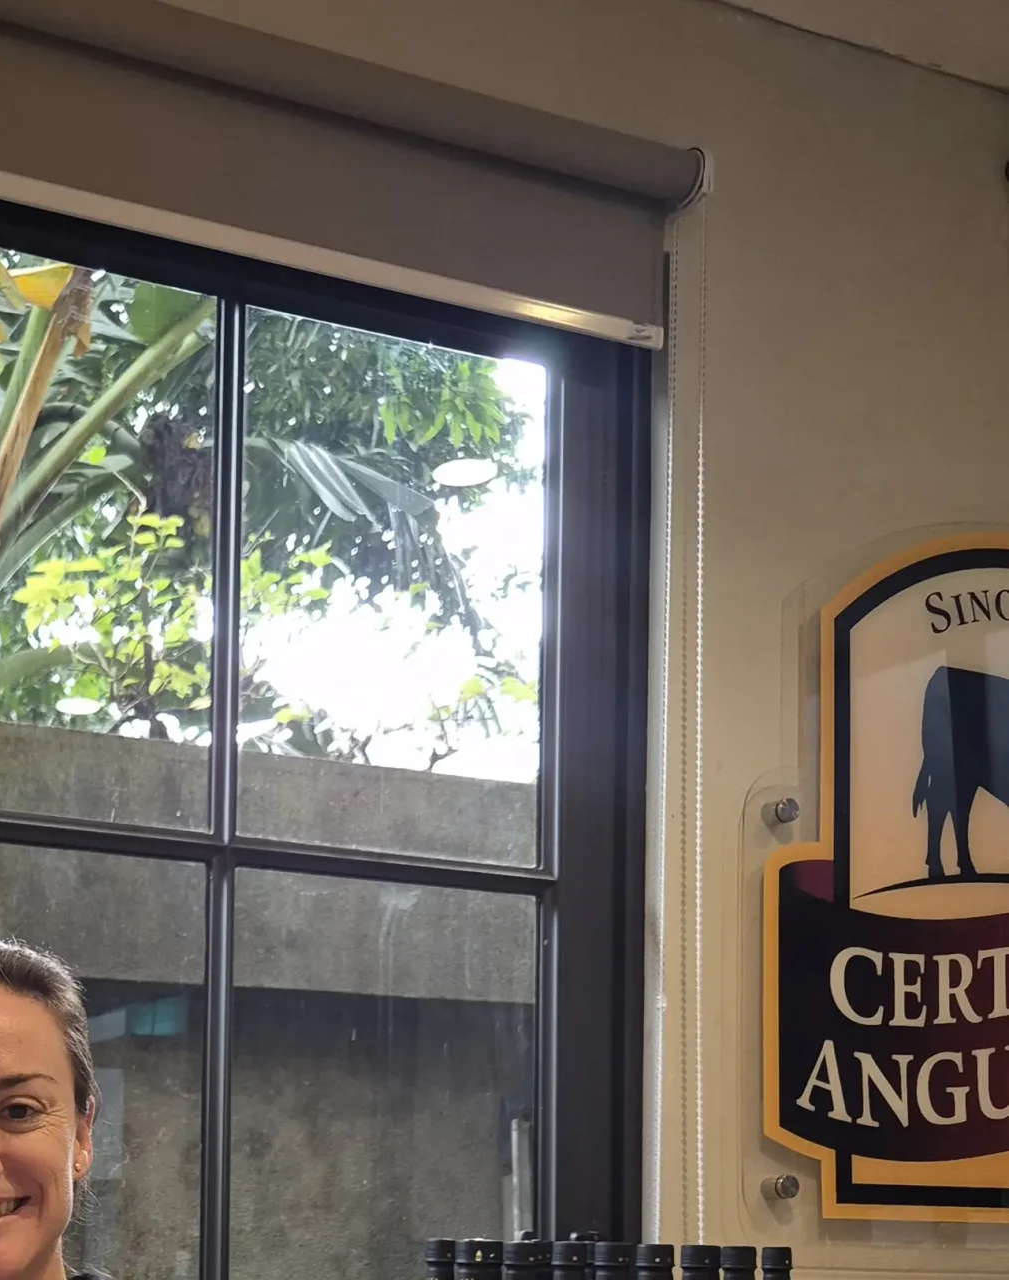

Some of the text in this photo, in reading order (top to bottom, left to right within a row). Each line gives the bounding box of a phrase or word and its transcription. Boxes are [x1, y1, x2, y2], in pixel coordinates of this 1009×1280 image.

[924, 589, 1009, 634] SINC
[828, 946, 1009, 1028] CERT
[796, 1039, 1009, 1128] ANGU
